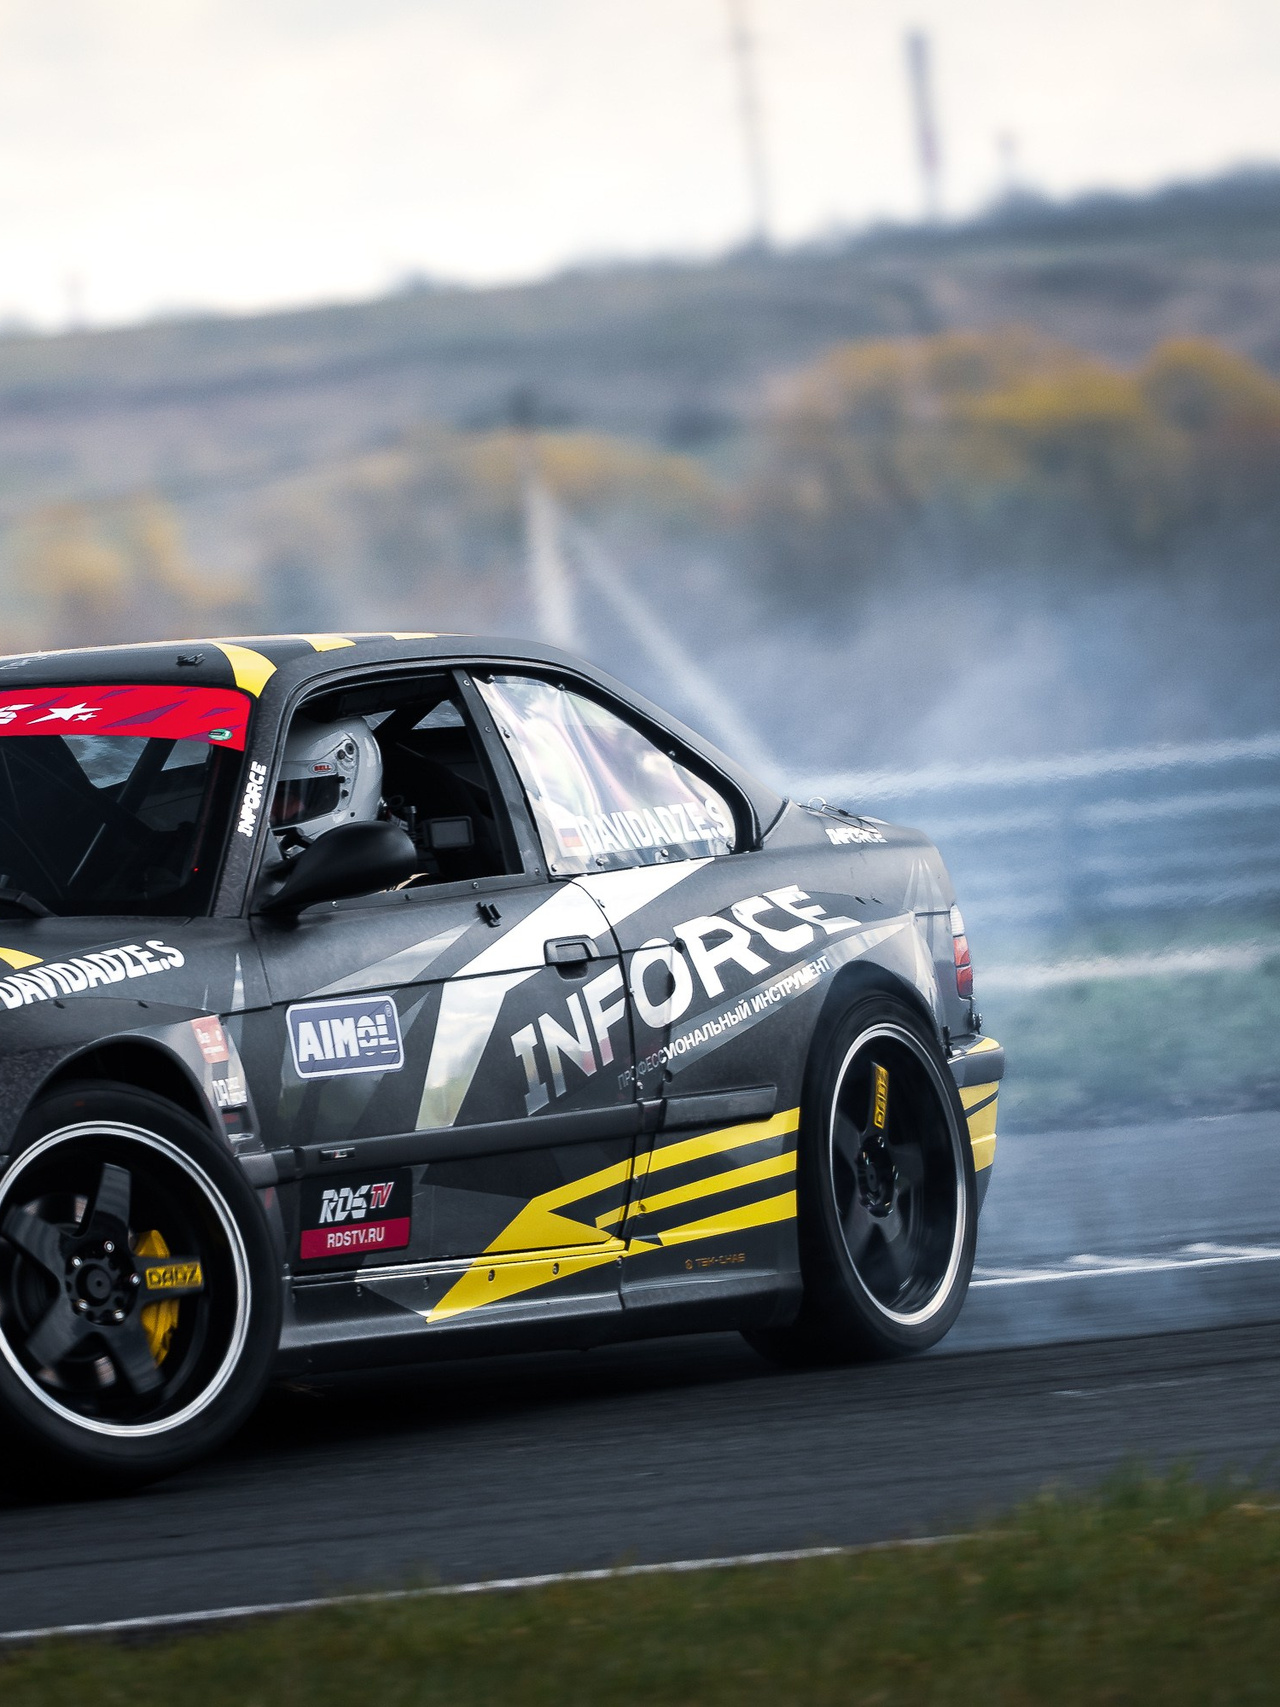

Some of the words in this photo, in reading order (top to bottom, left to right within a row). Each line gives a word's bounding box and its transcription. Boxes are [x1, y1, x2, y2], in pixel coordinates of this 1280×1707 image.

[237, 761, 267, 837] INFORCE
[510, 884, 862, 1116] INFORCE
[750, 956, 831, 1012] ИНСТРУМЕНТ
[326, 1226, 386, 1249] RDSTV.RU
